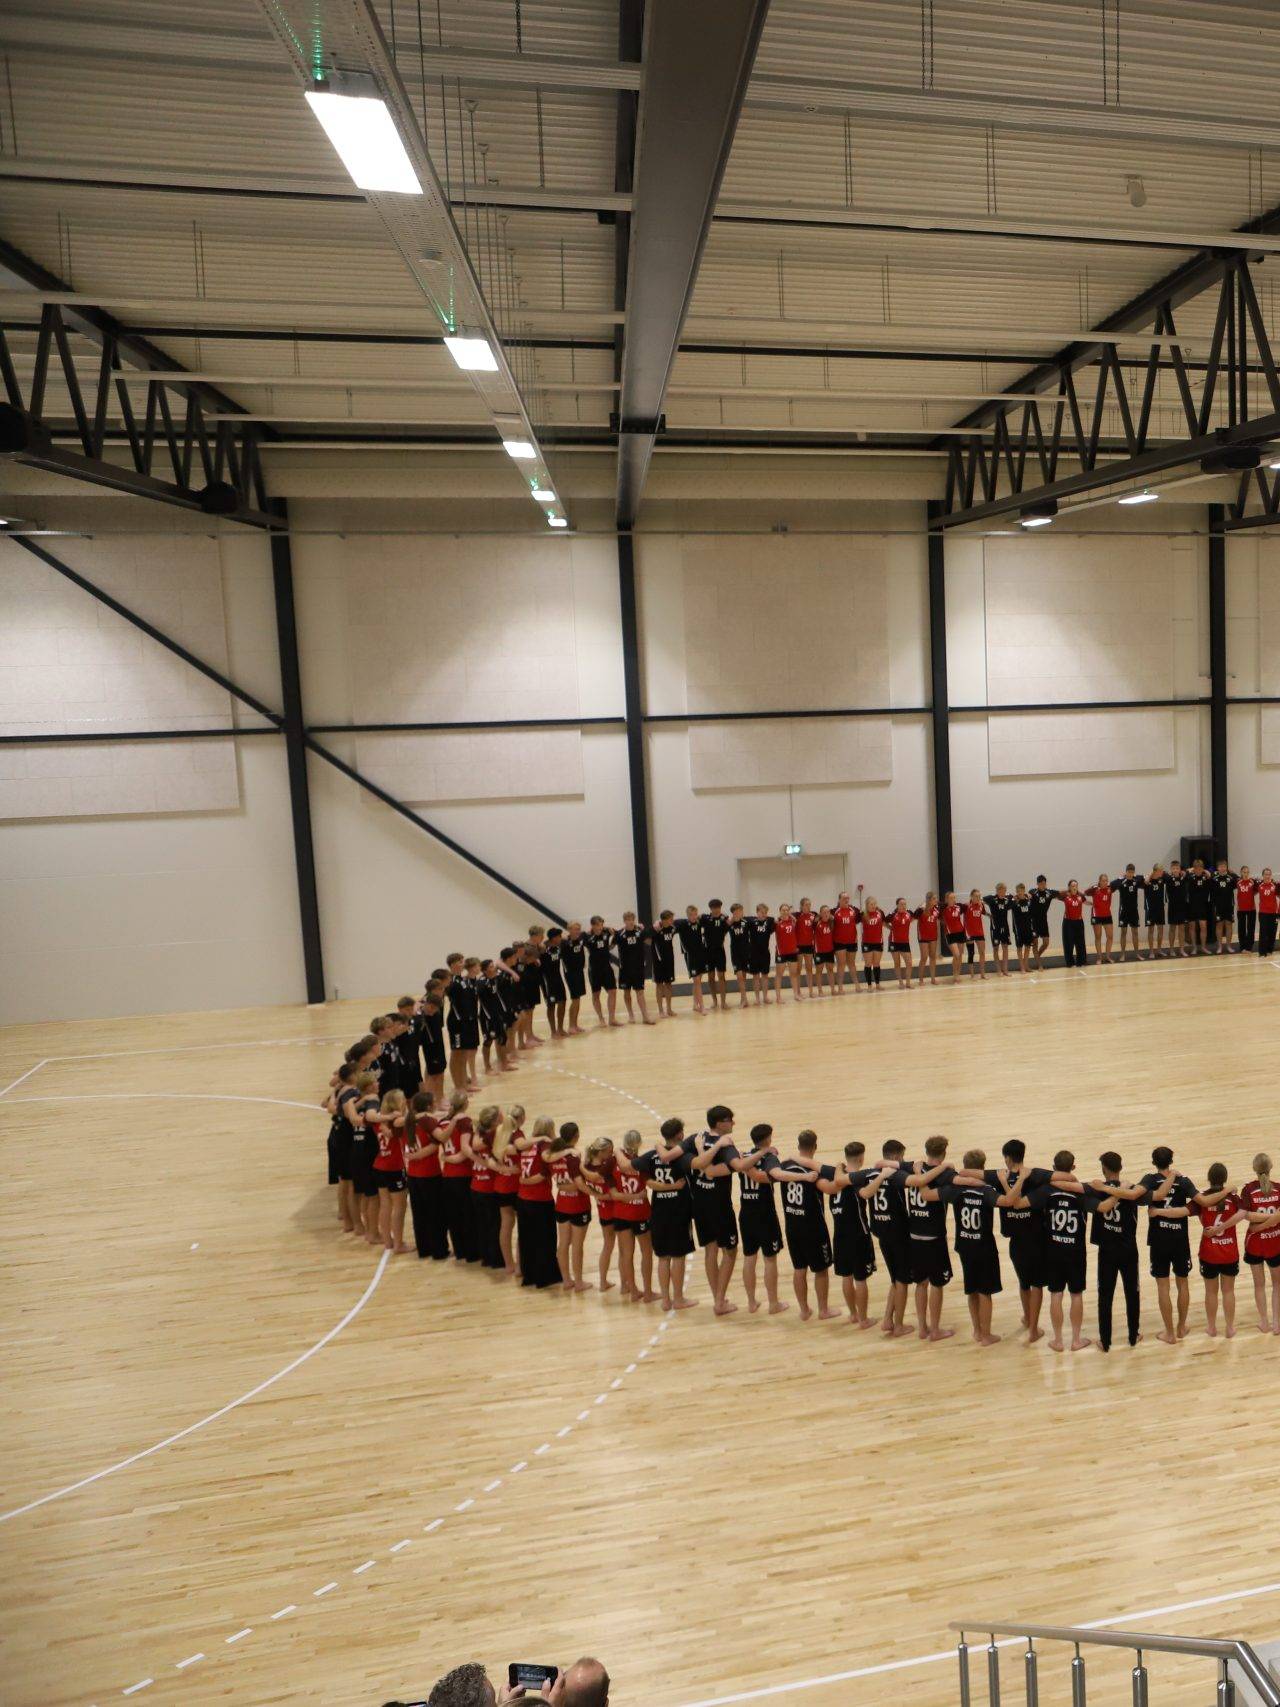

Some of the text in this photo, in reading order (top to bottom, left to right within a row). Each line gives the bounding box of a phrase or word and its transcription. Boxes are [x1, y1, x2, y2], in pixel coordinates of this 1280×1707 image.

[785, 925, 793, 934] 27
[786, 1181, 803, 1205] 88
[960, 1206, 981, 1230] 80
[1049, 1209, 1078, 1234] 195
